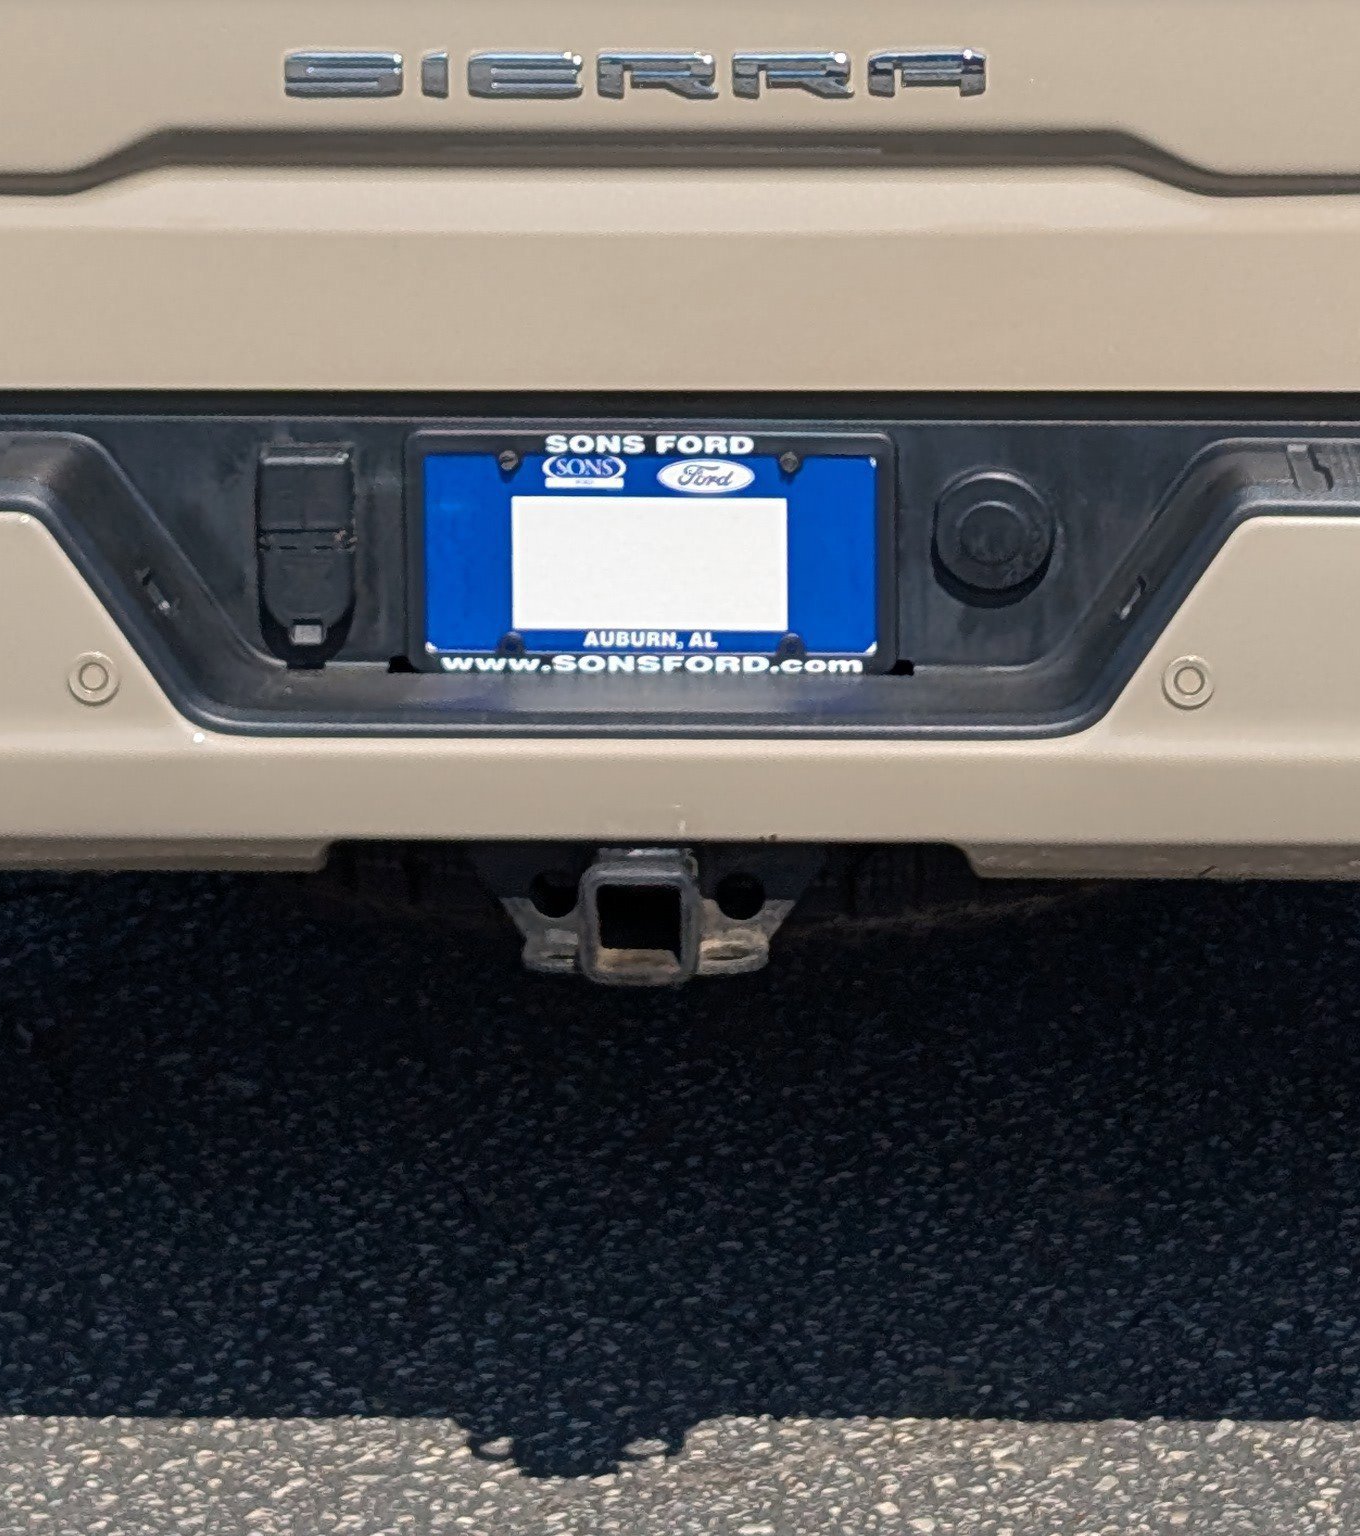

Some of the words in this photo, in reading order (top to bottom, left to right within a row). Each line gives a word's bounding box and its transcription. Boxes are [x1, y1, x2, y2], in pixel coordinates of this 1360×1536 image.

[283, 50, 987, 99] SIERRA
[545, 435, 646, 454] SONS
[656, 435, 755, 455] FORD
[555, 457, 614, 476] SONS
[677, 464, 735, 487] Ford
[583, 631, 685, 650] AUBURN,
[688, 632, 719, 649] AL
[442, 655, 863, 674] www.SONSFORD.com
